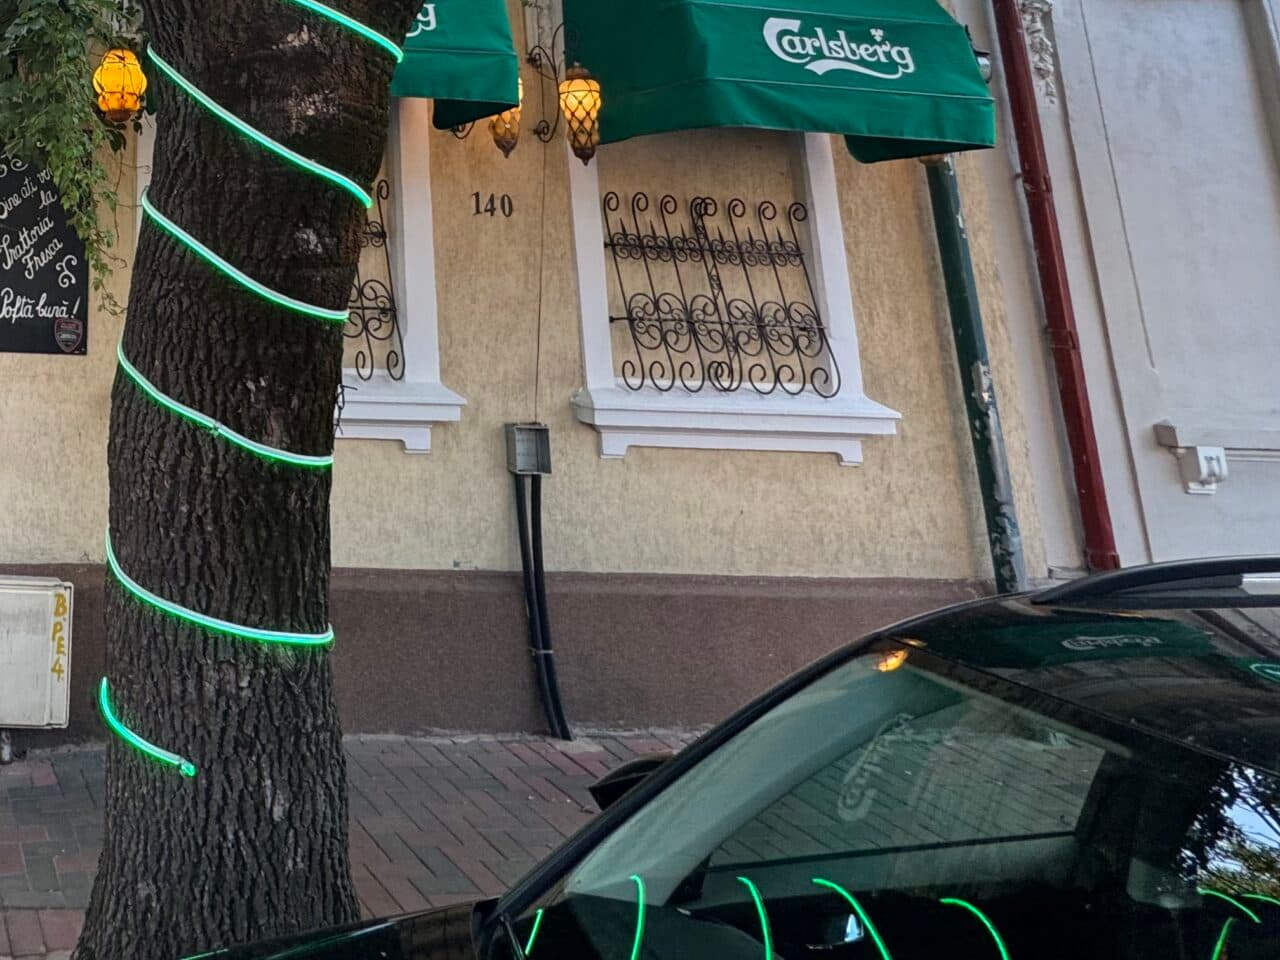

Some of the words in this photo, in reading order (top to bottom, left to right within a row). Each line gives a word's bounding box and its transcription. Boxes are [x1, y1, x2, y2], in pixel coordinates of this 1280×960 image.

[763, 17, 915, 79] Carlsberg
[39, 190, 58, 209] la
[471, 191, 513, 218] 140
[22, 238, 63, 280] Fresca
